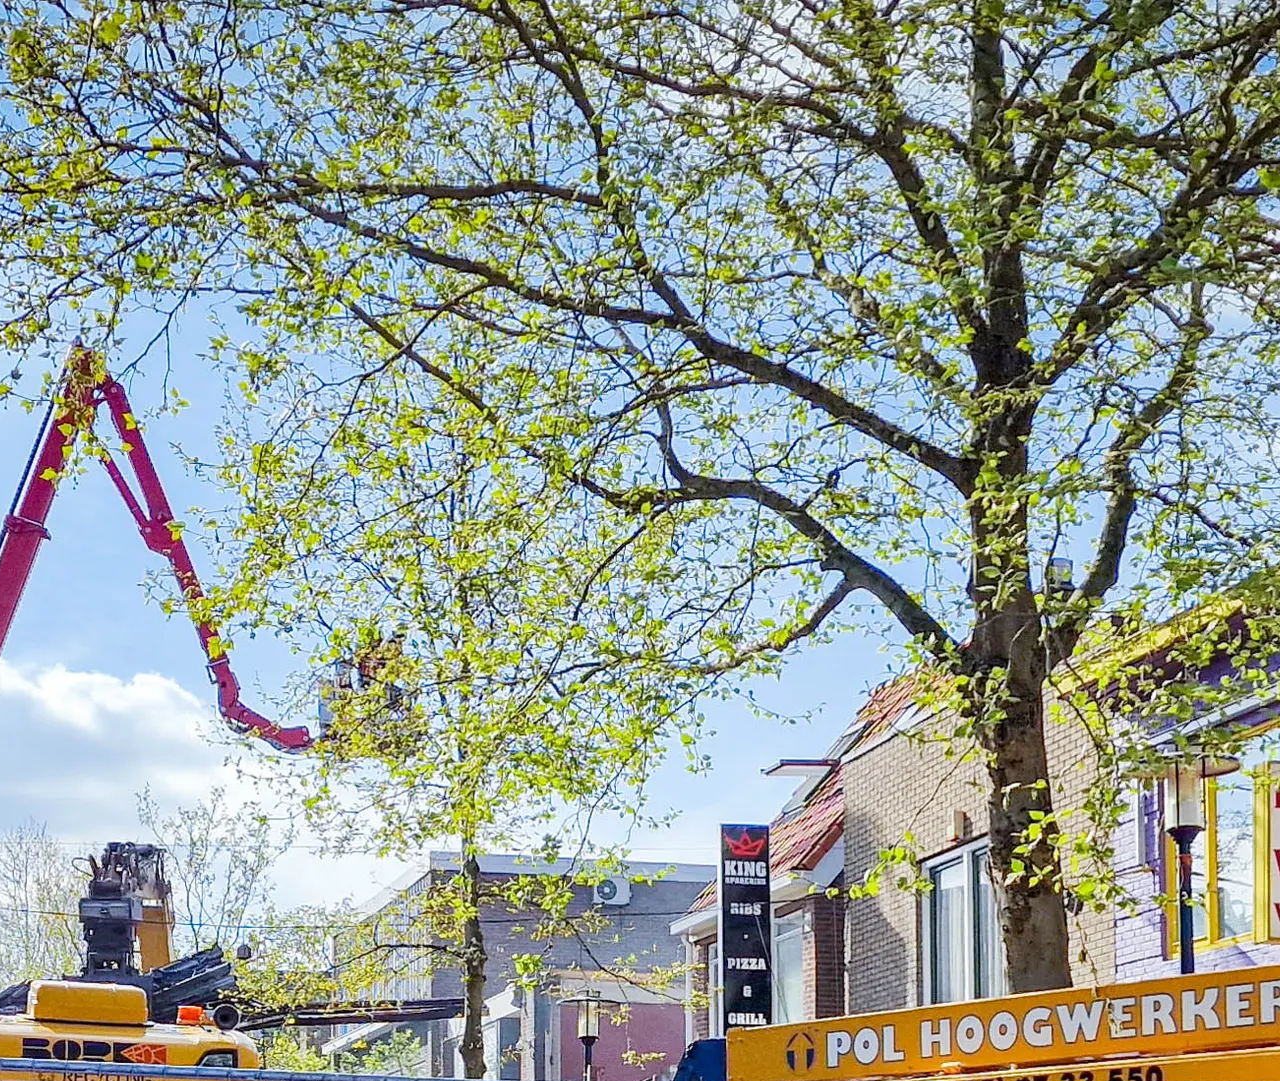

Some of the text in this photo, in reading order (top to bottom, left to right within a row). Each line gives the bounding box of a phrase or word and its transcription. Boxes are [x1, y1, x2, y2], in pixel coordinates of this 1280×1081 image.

[724, 861, 767, 877] KING
[727, 958, 767, 970] PIZZA
[728, 1012, 767, 1025] GRILL
[826, 1024, 905, 1068] POL
